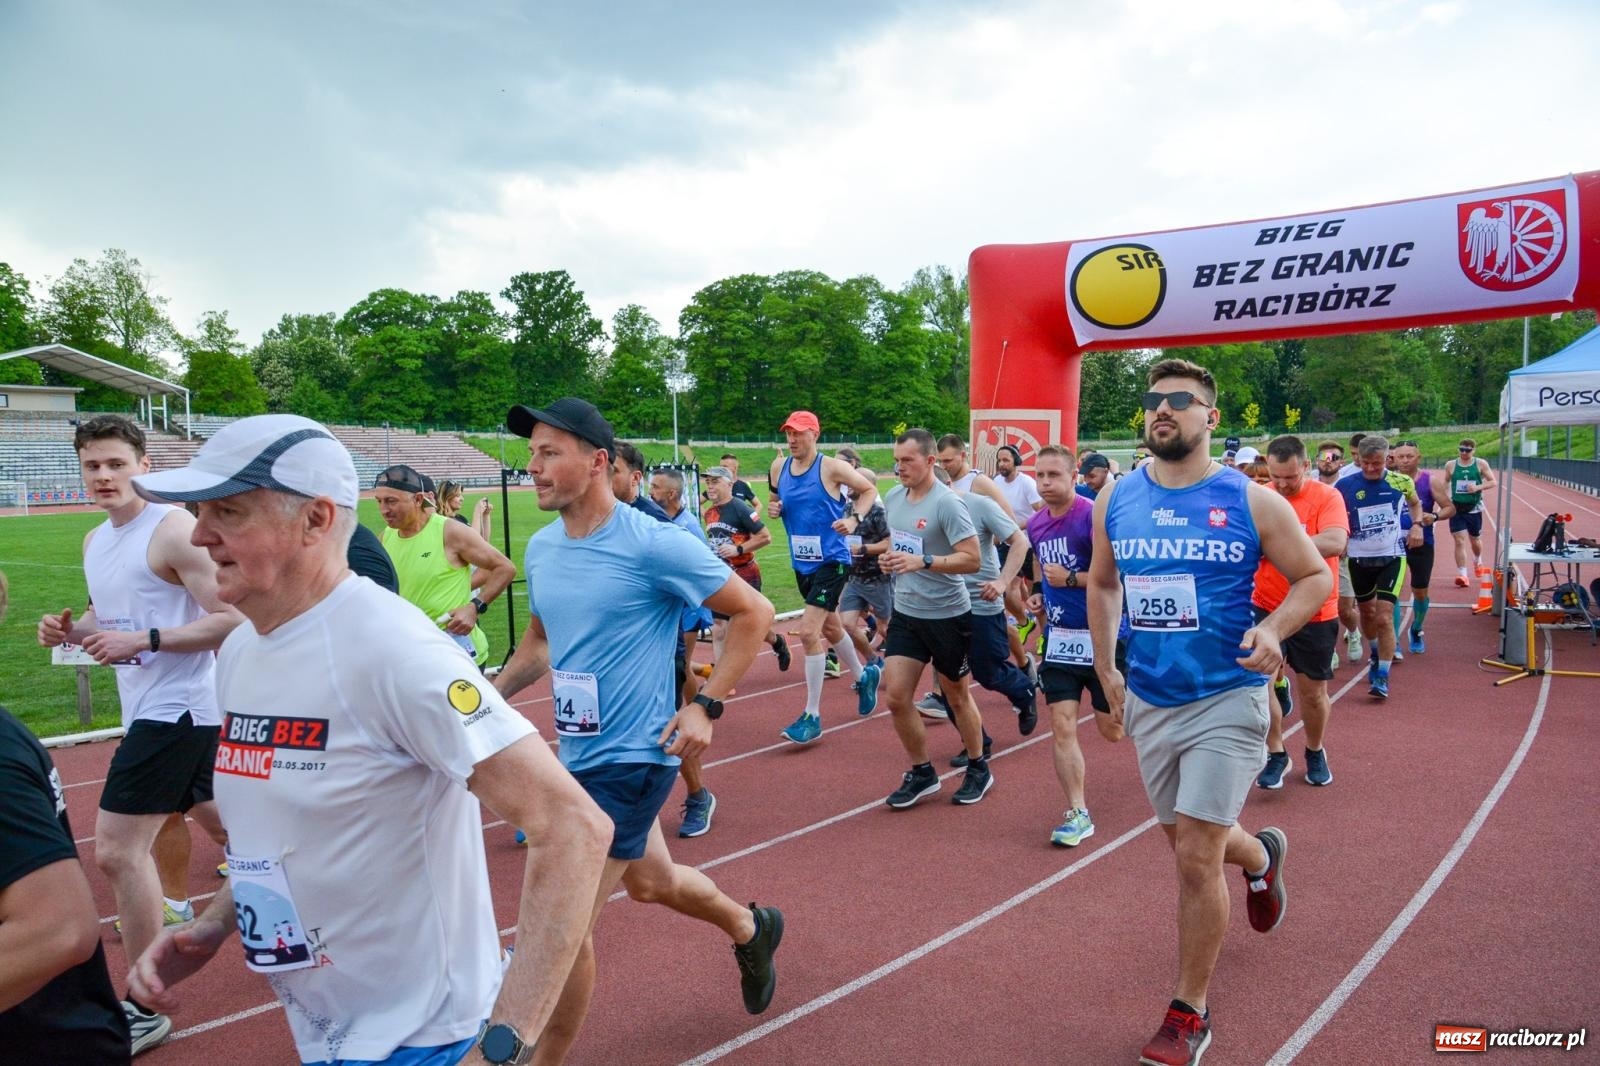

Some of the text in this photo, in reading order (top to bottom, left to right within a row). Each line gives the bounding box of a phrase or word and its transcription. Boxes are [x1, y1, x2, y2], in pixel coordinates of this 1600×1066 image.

[1255, 219, 1346, 246] BIEG
[1193, 242, 1414, 288] BEZ GRANIC
[1213, 282, 1396, 321] RACIBÓRZ
[1368, 514, 1386, 523] 232
[798, 545, 814, 555] 234
[1111, 538, 1246, 563] RUNNERS
[1140, 598, 1177, 616] 258
[1059, 642, 1084, 655] 240
[566, 673, 592, 681] GRANIC
[229, 716, 270, 743] BIEG
[272, 720, 323, 747] BEZ
[272, 760, 326, 771] 03.05.2017
